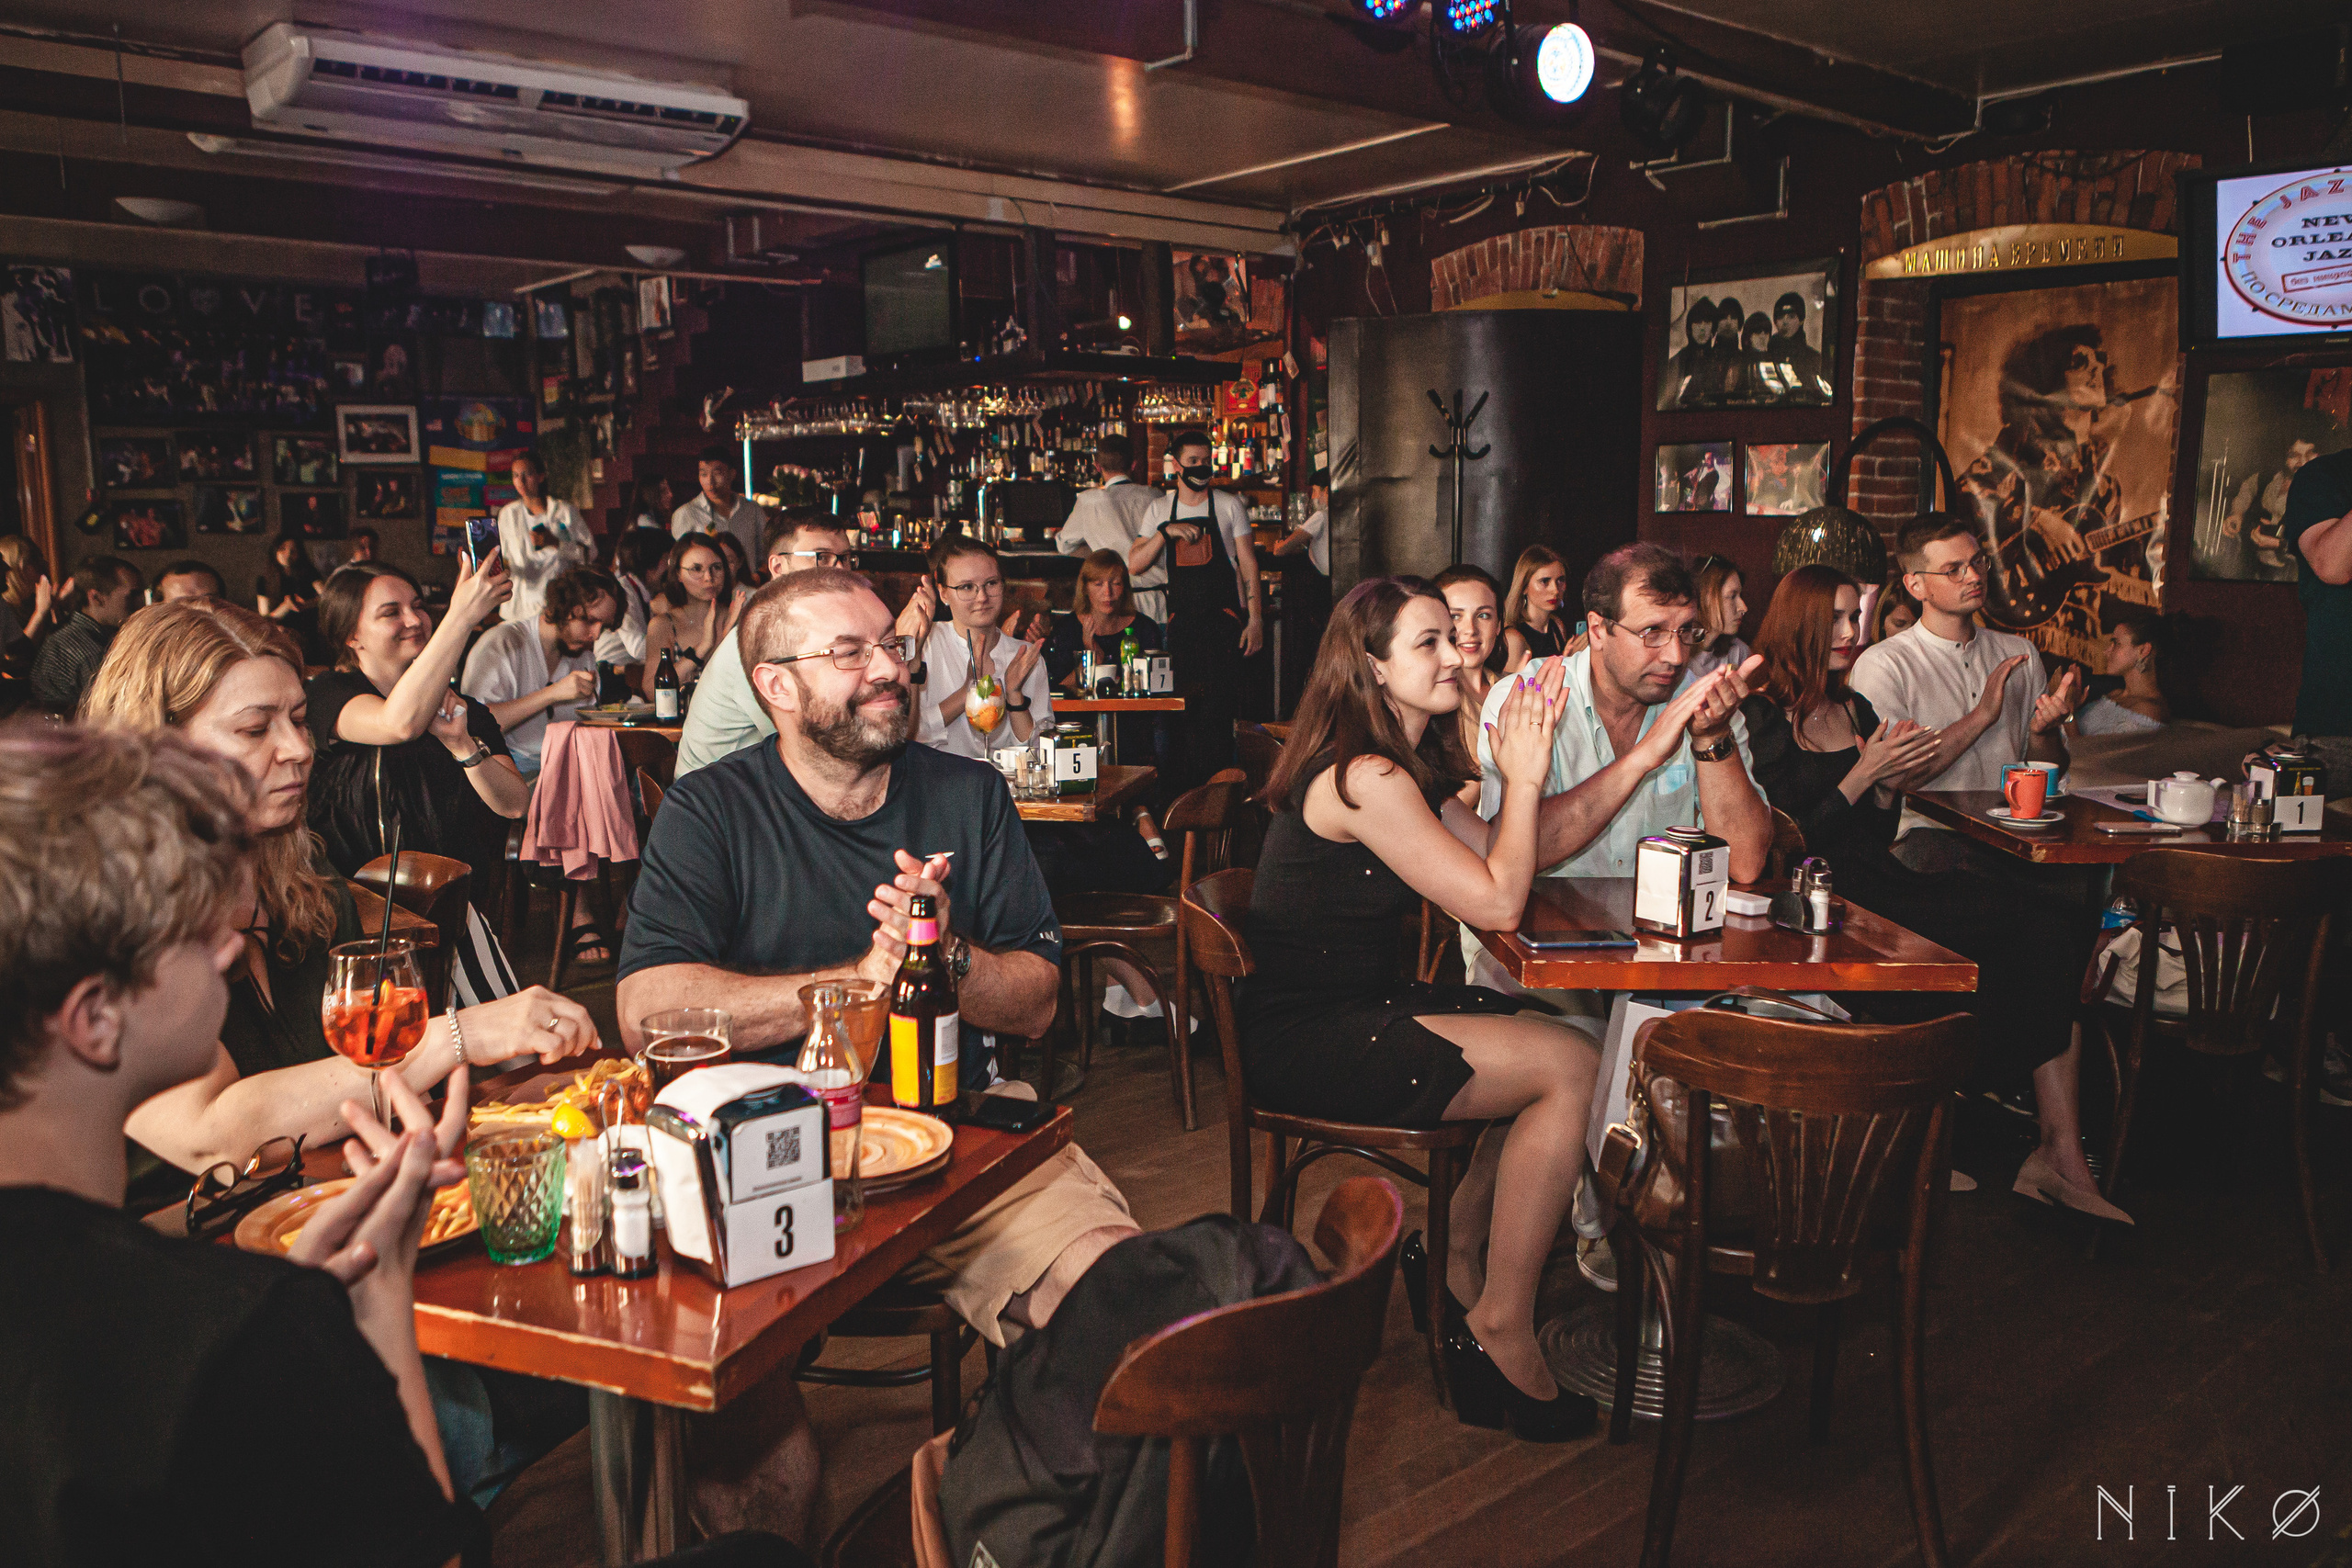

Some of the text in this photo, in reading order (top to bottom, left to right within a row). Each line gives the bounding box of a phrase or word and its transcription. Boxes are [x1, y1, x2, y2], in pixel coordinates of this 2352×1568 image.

[1905, 235, 2124, 274] МАШИНА ВРЕМЕНИ
[2233, 215, 2267, 264] THE
[1159, 673, 1166, 689] 7
[1072, 752, 1081, 774] 5
[2297, 801, 2304, 825] 1
[1705, 890, 1715, 921] 2
[775, 1205, 796, 1258] 3
